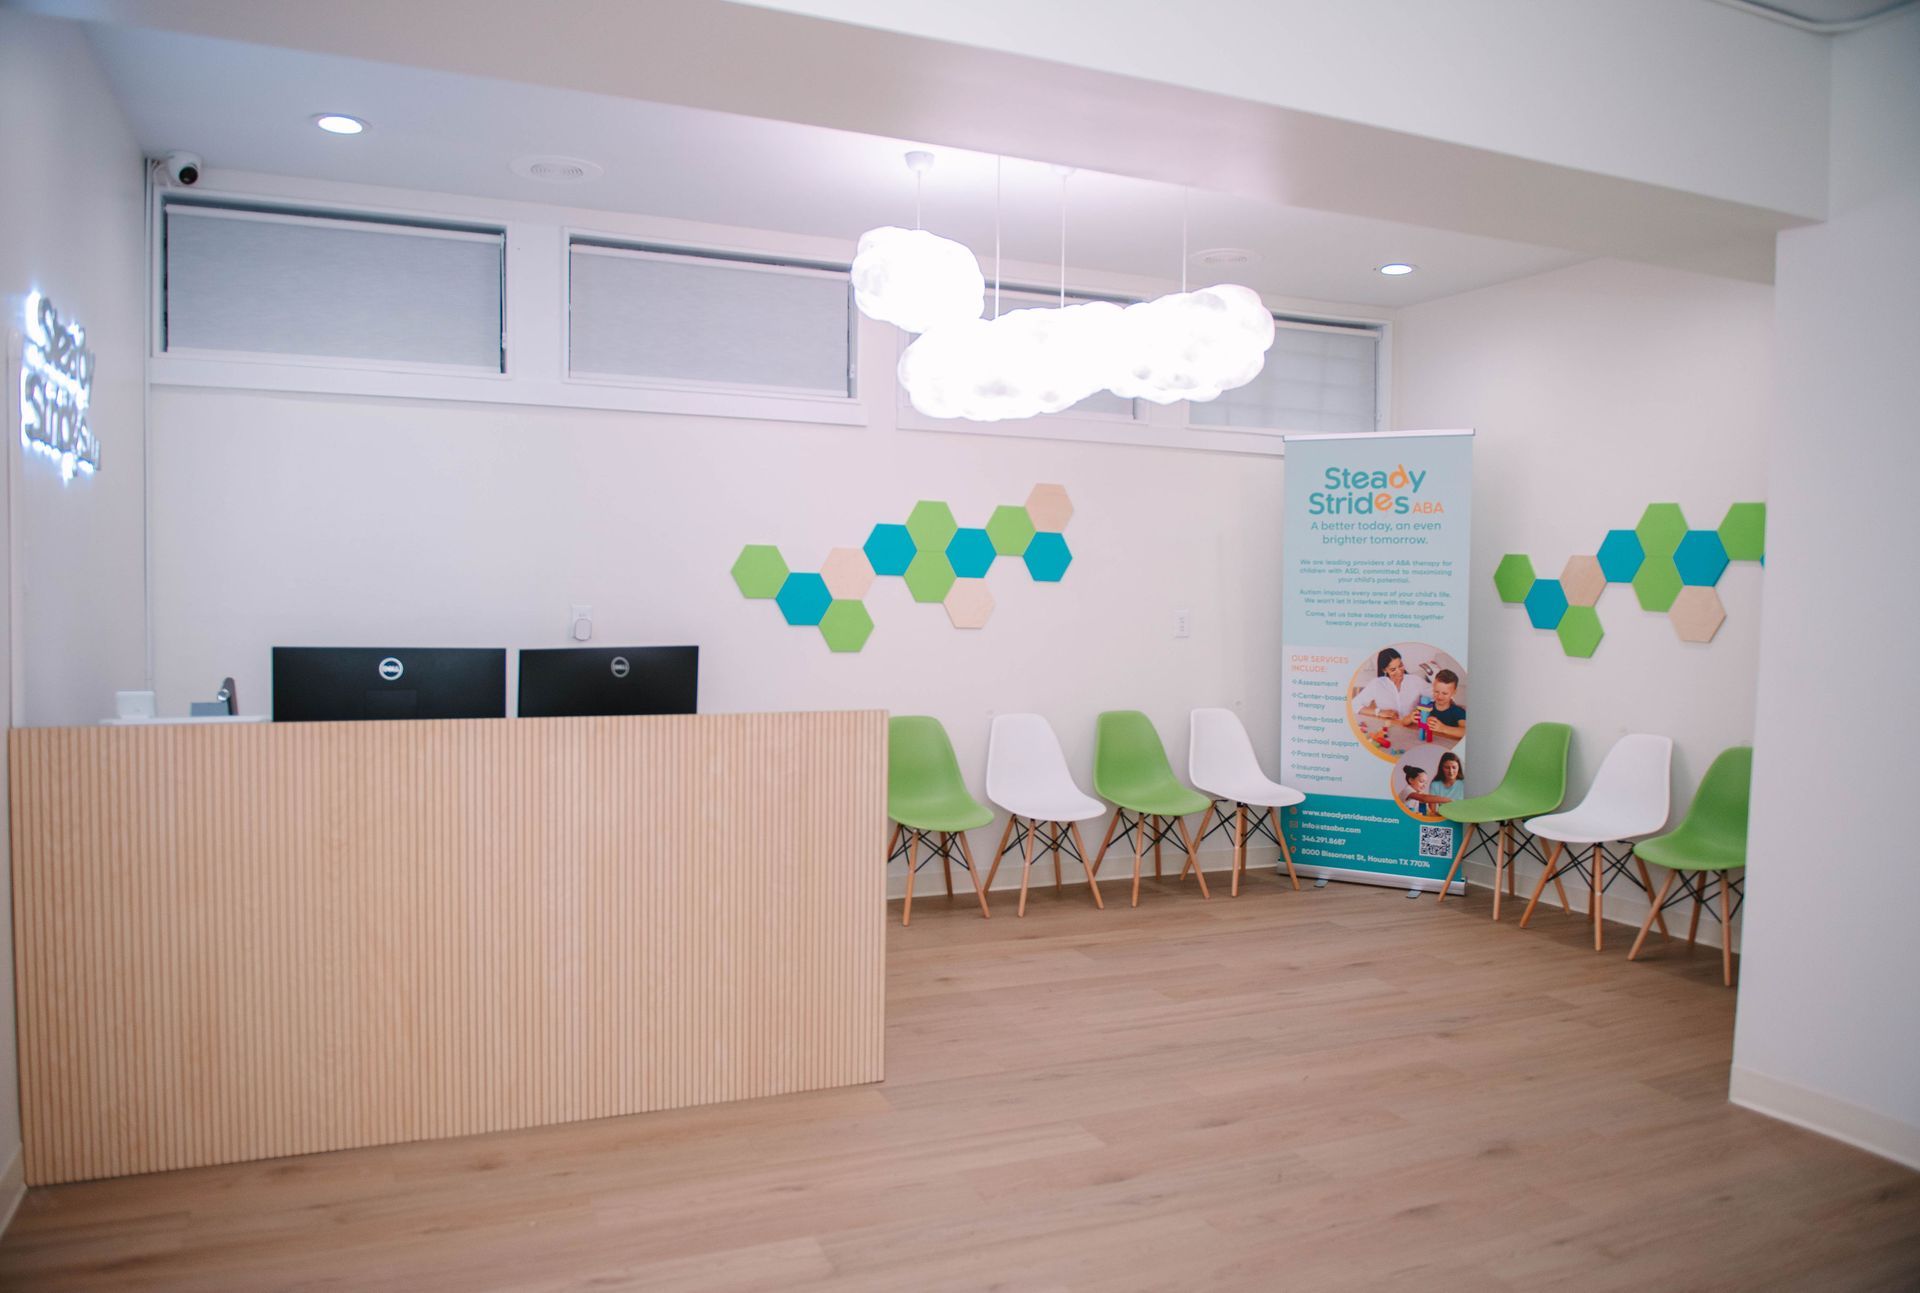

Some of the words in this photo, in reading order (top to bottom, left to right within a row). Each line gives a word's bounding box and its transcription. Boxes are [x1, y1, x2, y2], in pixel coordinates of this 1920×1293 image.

[1325, 464, 1426, 493] Steady
[1309, 492, 1410, 515] Strides
[1412, 501, 1444, 514] ABA
[1311, 521, 1318, 530] A
[1321, 520, 1355, 530] better
[1358, 520, 1392, 532] today,
[1413, 522, 1441, 530] even
[1322, 535, 1367, 546] brighter
[1370, 536, 1428, 544] tomorrow.
[1411, 569, 1453, 577] maximizing
[1413, 613, 1444, 621] together
[1291, 655, 1309, 663] OUR
[1311, 655, 1349, 665] SERVICES
[1297, 679, 1339, 687] Assessment
[1296, 692, 1347, 702] Center-based
[1298, 702, 1325, 711] therapy
[1297, 715, 1344, 724] Home-based
[1298, 724, 1325, 733] therapy
[1331, 740, 1360, 748] support
[1297, 750, 1320, 758] Parent
[1321, 752, 1350, 762] training
[1296, 764, 1331, 772] Insurance
[1295, 773, 1343, 782] management
[1302, 810, 1400, 825] www.steadystridesaba.com
[1301, 821, 1361, 834] info@stsaba.com
[1301, 848, 1321, 857] 8000
[1321, 850, 1355, 860] Bissonnet
[1367, 855, 1399, 865] Houston
[1399, 858, 1409, 866] TX
[1409, 859, 1431, 868] 77074
